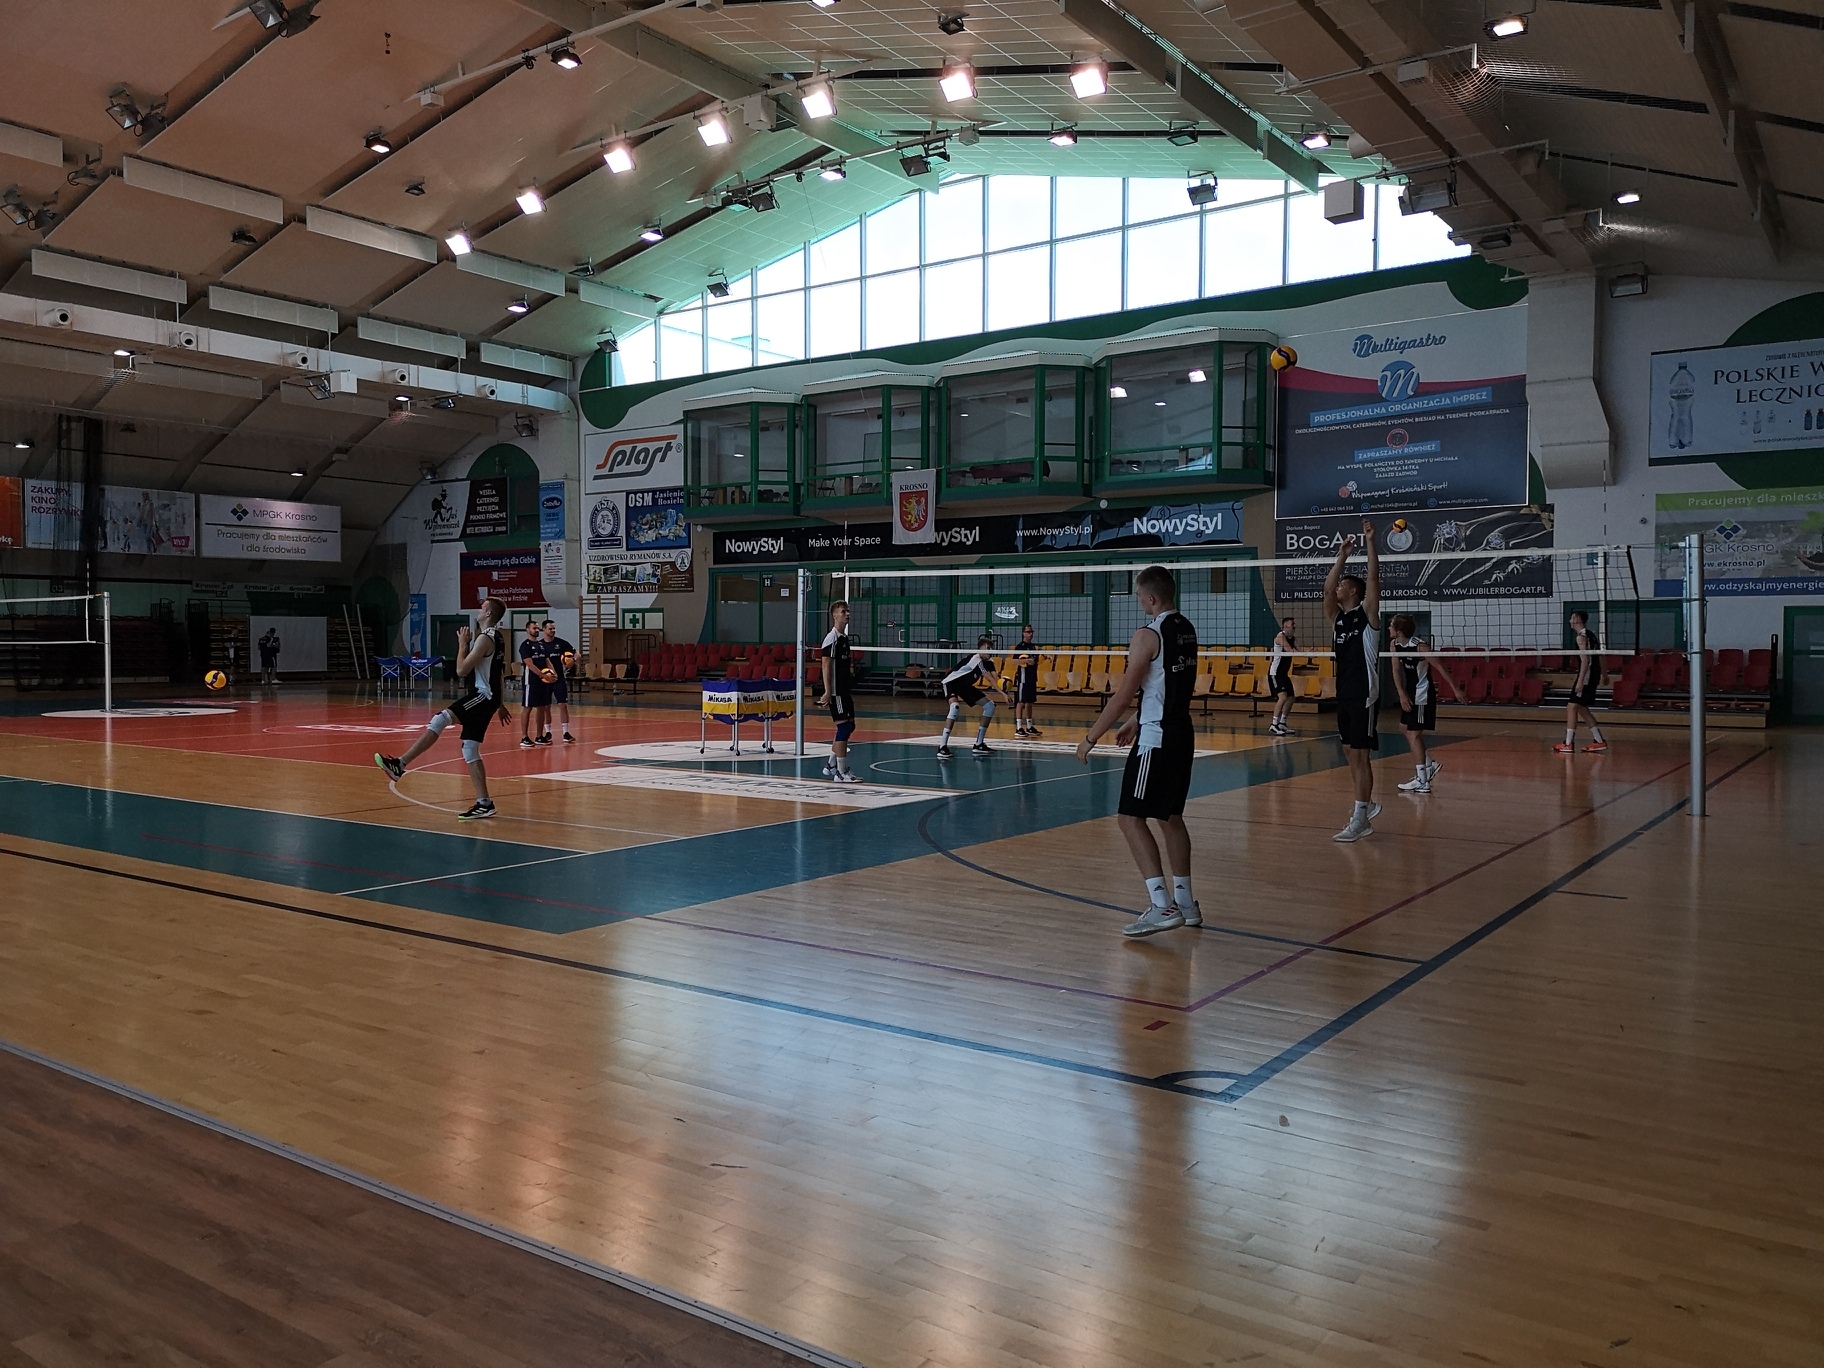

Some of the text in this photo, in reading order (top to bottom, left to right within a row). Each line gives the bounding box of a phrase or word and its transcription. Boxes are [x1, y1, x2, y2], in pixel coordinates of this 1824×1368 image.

[1352, 334, 1447, 358] Multigastro
[1713, 364, 1800, 385] POLSKIE
[1314, 405, 1386, 423] PROFESJONALNA
[1388, 397, 1450, 413] ORGANIZACJA
[1357, 449, 1403, 459] ZAPRASZAMY
[899, 482, 928, 491] KROSNO
[628, 492, 653, 508] OSM
[1688, 495, 1753, 508] Pracujemy
[1757, 492, 1776, 503] dla
[31, 506, 84, 517] ROZRYWK
[252, 508, 318, 522] MPGK Krosno
[216, 528, 328, 544] Pracujemy dla mieszkańców
[934, 513, 1222, 546] wyStyl www.NowyStyl.pl NowyStyl
[246, 544, 261, 552] dla
[262, 545, 307, 555] środowiska
[725, 536, 881, 555] NowyStyl Make Your Space
[1704, 543, 1775, 554] GK Krosno
[473, 557, 502, 567] Zmieniamy
[519, 555, 536, 564] Ciebie
[588, 553, 628, 562] UZDROWISKO
[629, 551, 662, 561] RYMANÓW
[596, 584, 659, 593] ZAPRASZAMY!!!
[1293, 591, 1324, 599] PIŁSUDS
[1392, 588, 1428, 598] KROSNO
[1442, 586, 1547, 596] WWW.JUBILERBOGART.PL
